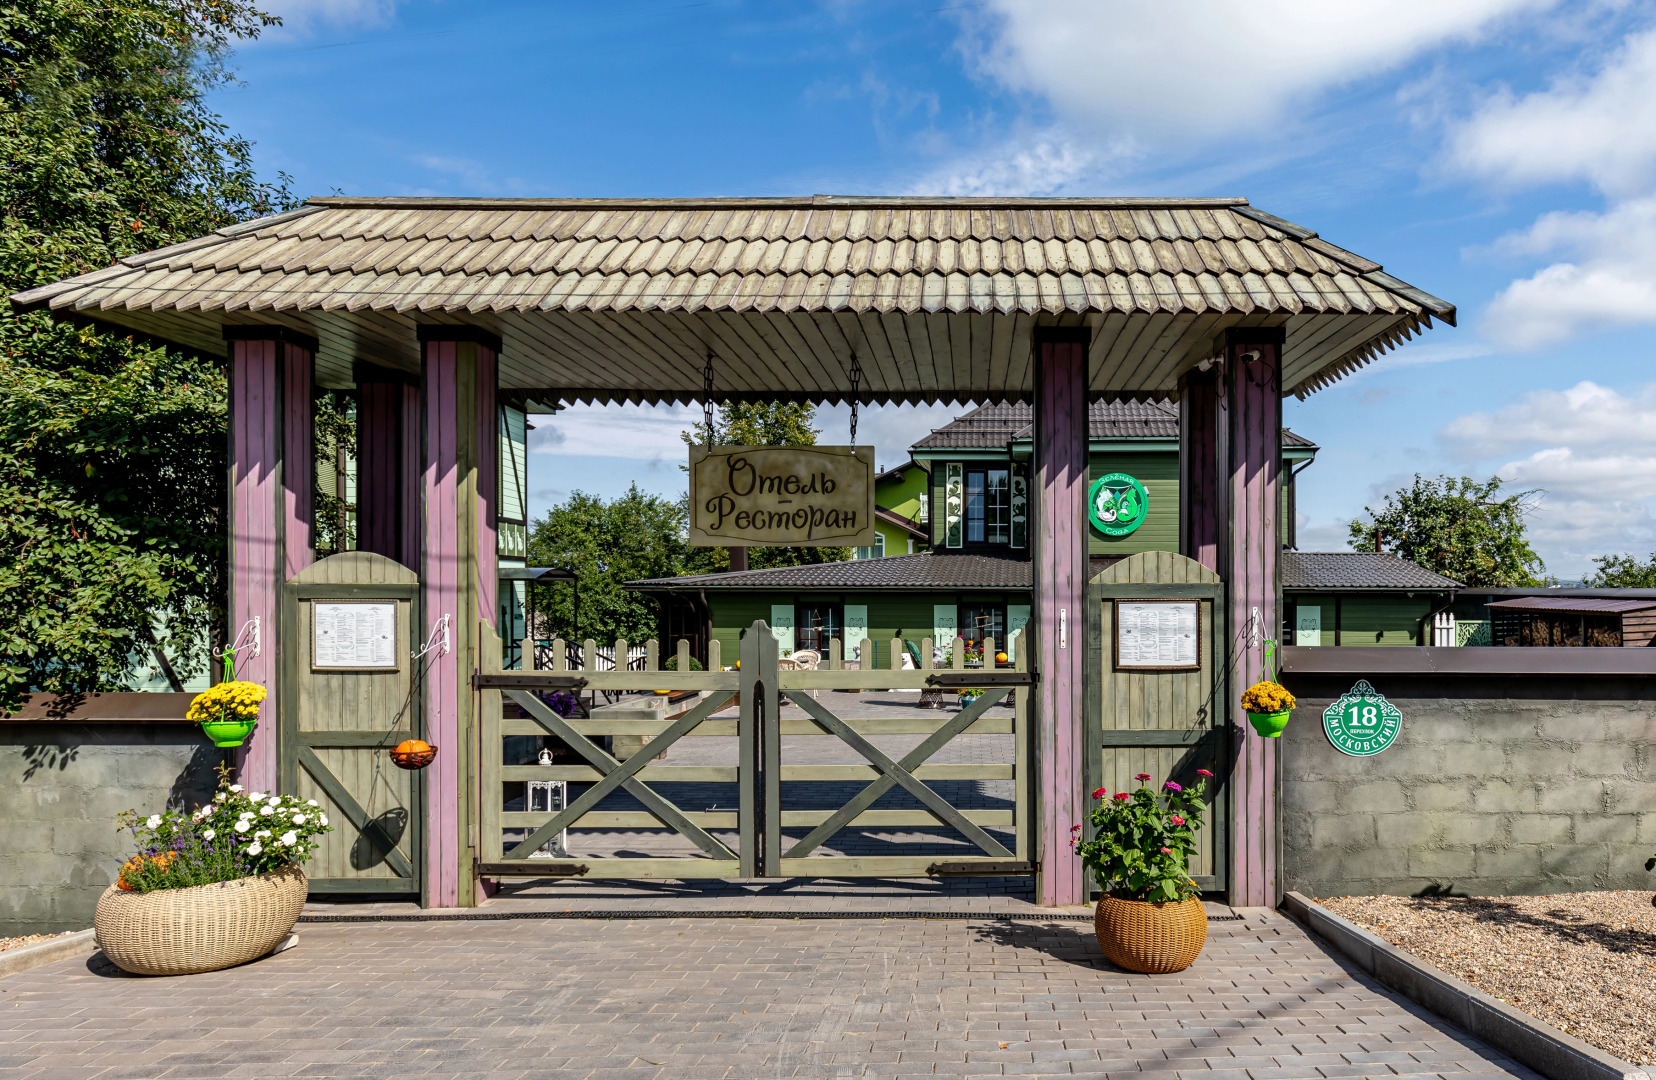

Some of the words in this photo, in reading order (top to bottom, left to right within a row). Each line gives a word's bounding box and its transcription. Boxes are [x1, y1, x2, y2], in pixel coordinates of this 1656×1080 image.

[727, 454, 836, 497] Отель
[705, 493, 856, 539] Ресторан
[1329, 718, 1396, 751] МОСКОВСКИЙ
[1348, 706, 1377, 726] 18
